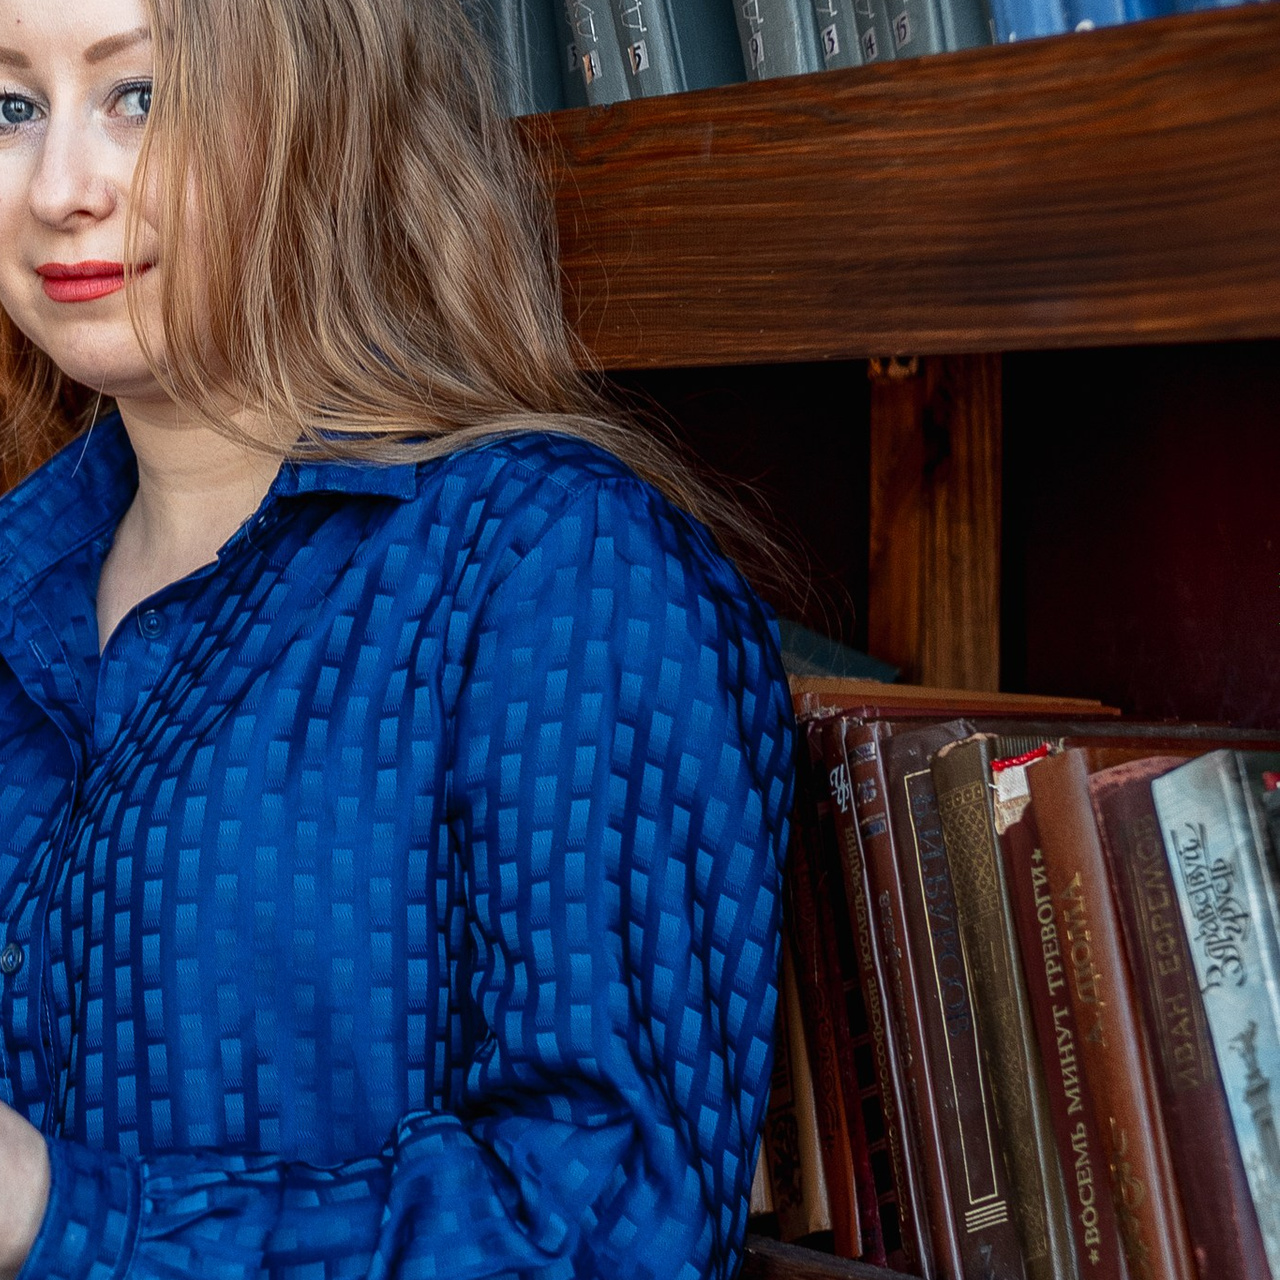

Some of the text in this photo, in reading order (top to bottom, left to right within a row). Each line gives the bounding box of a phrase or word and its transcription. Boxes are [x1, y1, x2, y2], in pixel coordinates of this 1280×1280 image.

[632, 46, 642, 70] 5
[894, 15, 908, 43] 15
[1031, 866, 1101, 1248] ВОСЕМЬ МИНУТ ТРЕВОГИ
[1168, 992, 1199, 1090] ИВАН
